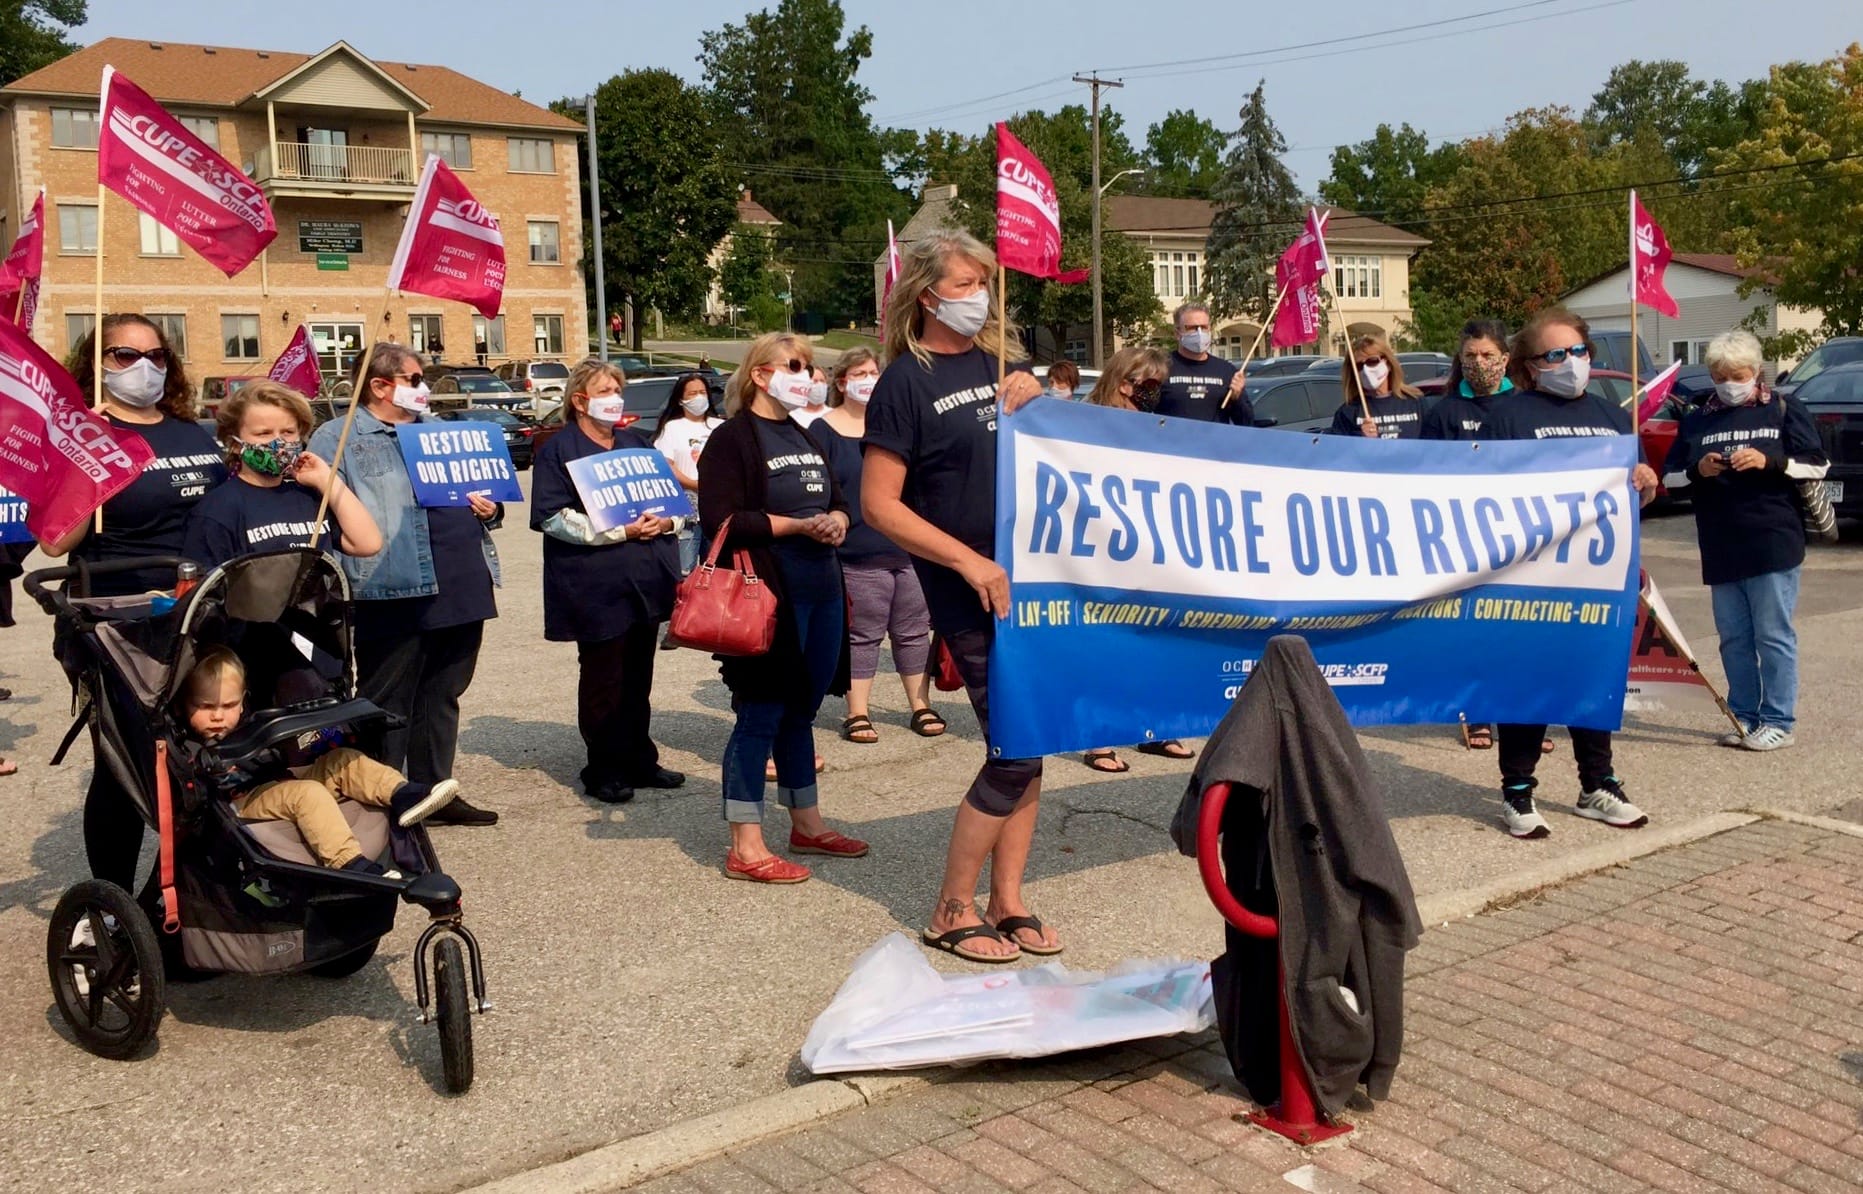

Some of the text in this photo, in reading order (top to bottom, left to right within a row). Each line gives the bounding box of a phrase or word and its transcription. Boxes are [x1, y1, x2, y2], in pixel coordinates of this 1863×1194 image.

[130, 115, 203, 168] CUPE
[125, 174, 141, 190] FOR
[129, 163, 166, 195] FIGHTING
[1000, 157, 1045, 200] CUPE
[176, 212, 200, 230] POUR
[181, 200, 217, 227] LUTTER
[219, 194, 264, 230] Ontario
[437, 255, 451, 265] FOR
[442, 245, 477, 261] FIGHTING
[432, 264, 468, 280] FAIRNESS
[19, 359, 133, 470] CUPE SCFP
[933, 389, 977, 415] RESTORE
[3, 436, 22, 450] FOR
[418, 430, 493, 456] RESTORE
[1701, 428, 1780, 445] RESTORE OUR RIGHTS
[57, 436, 102, 478] Ontario
[592, 455, 660, 483] RESTORE
[415, 457, 510, 484] OUR RIGHTS
[180, 486, 205, 497] CUPE
[591, 478, 680, 511] OUR RIGHTS
[1029, 460, 1619, 576] RESTORE OUR RIGHTS
[246, 522, 292, 545] RESTORE
[1018, 600, 1071, 628] LAY-OFF
[1082, 602, 1170, 627] SENIORITY
[1473, 597, 1611, 625] CONTRACTING-OUT
[1356, 663, 1388, 677] SCFP
